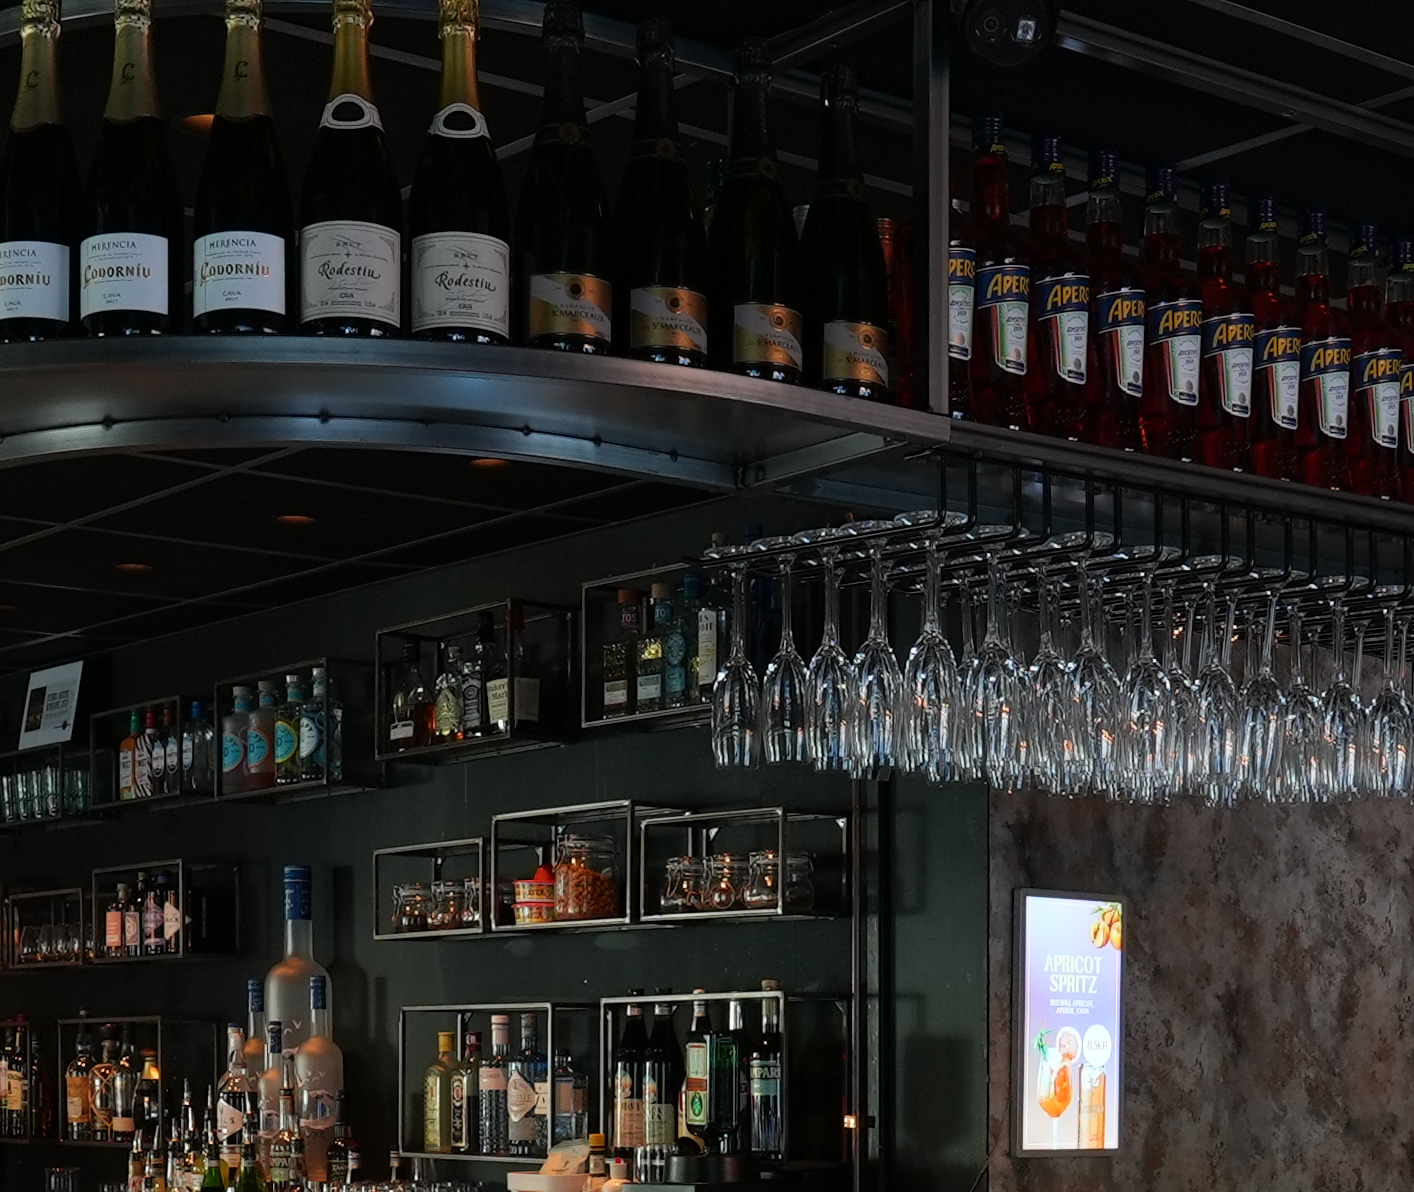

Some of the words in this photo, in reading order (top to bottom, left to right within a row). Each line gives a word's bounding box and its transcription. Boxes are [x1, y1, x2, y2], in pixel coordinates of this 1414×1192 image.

[91, 240, 137, 252] HERENCIA
[209, 238, 257, 250] HERENCIA
[84, 264, 150, 290] CODORNÍU
[200, 262, 269, 286] CODORNÍU
[317, 260, 381, 280] Rodestiu
[435, 271, 497, 292] Rodestiu
[1044, 954, 1103, 974] APRICOT
[1050, 974, 1097, 993] SPRITZ
